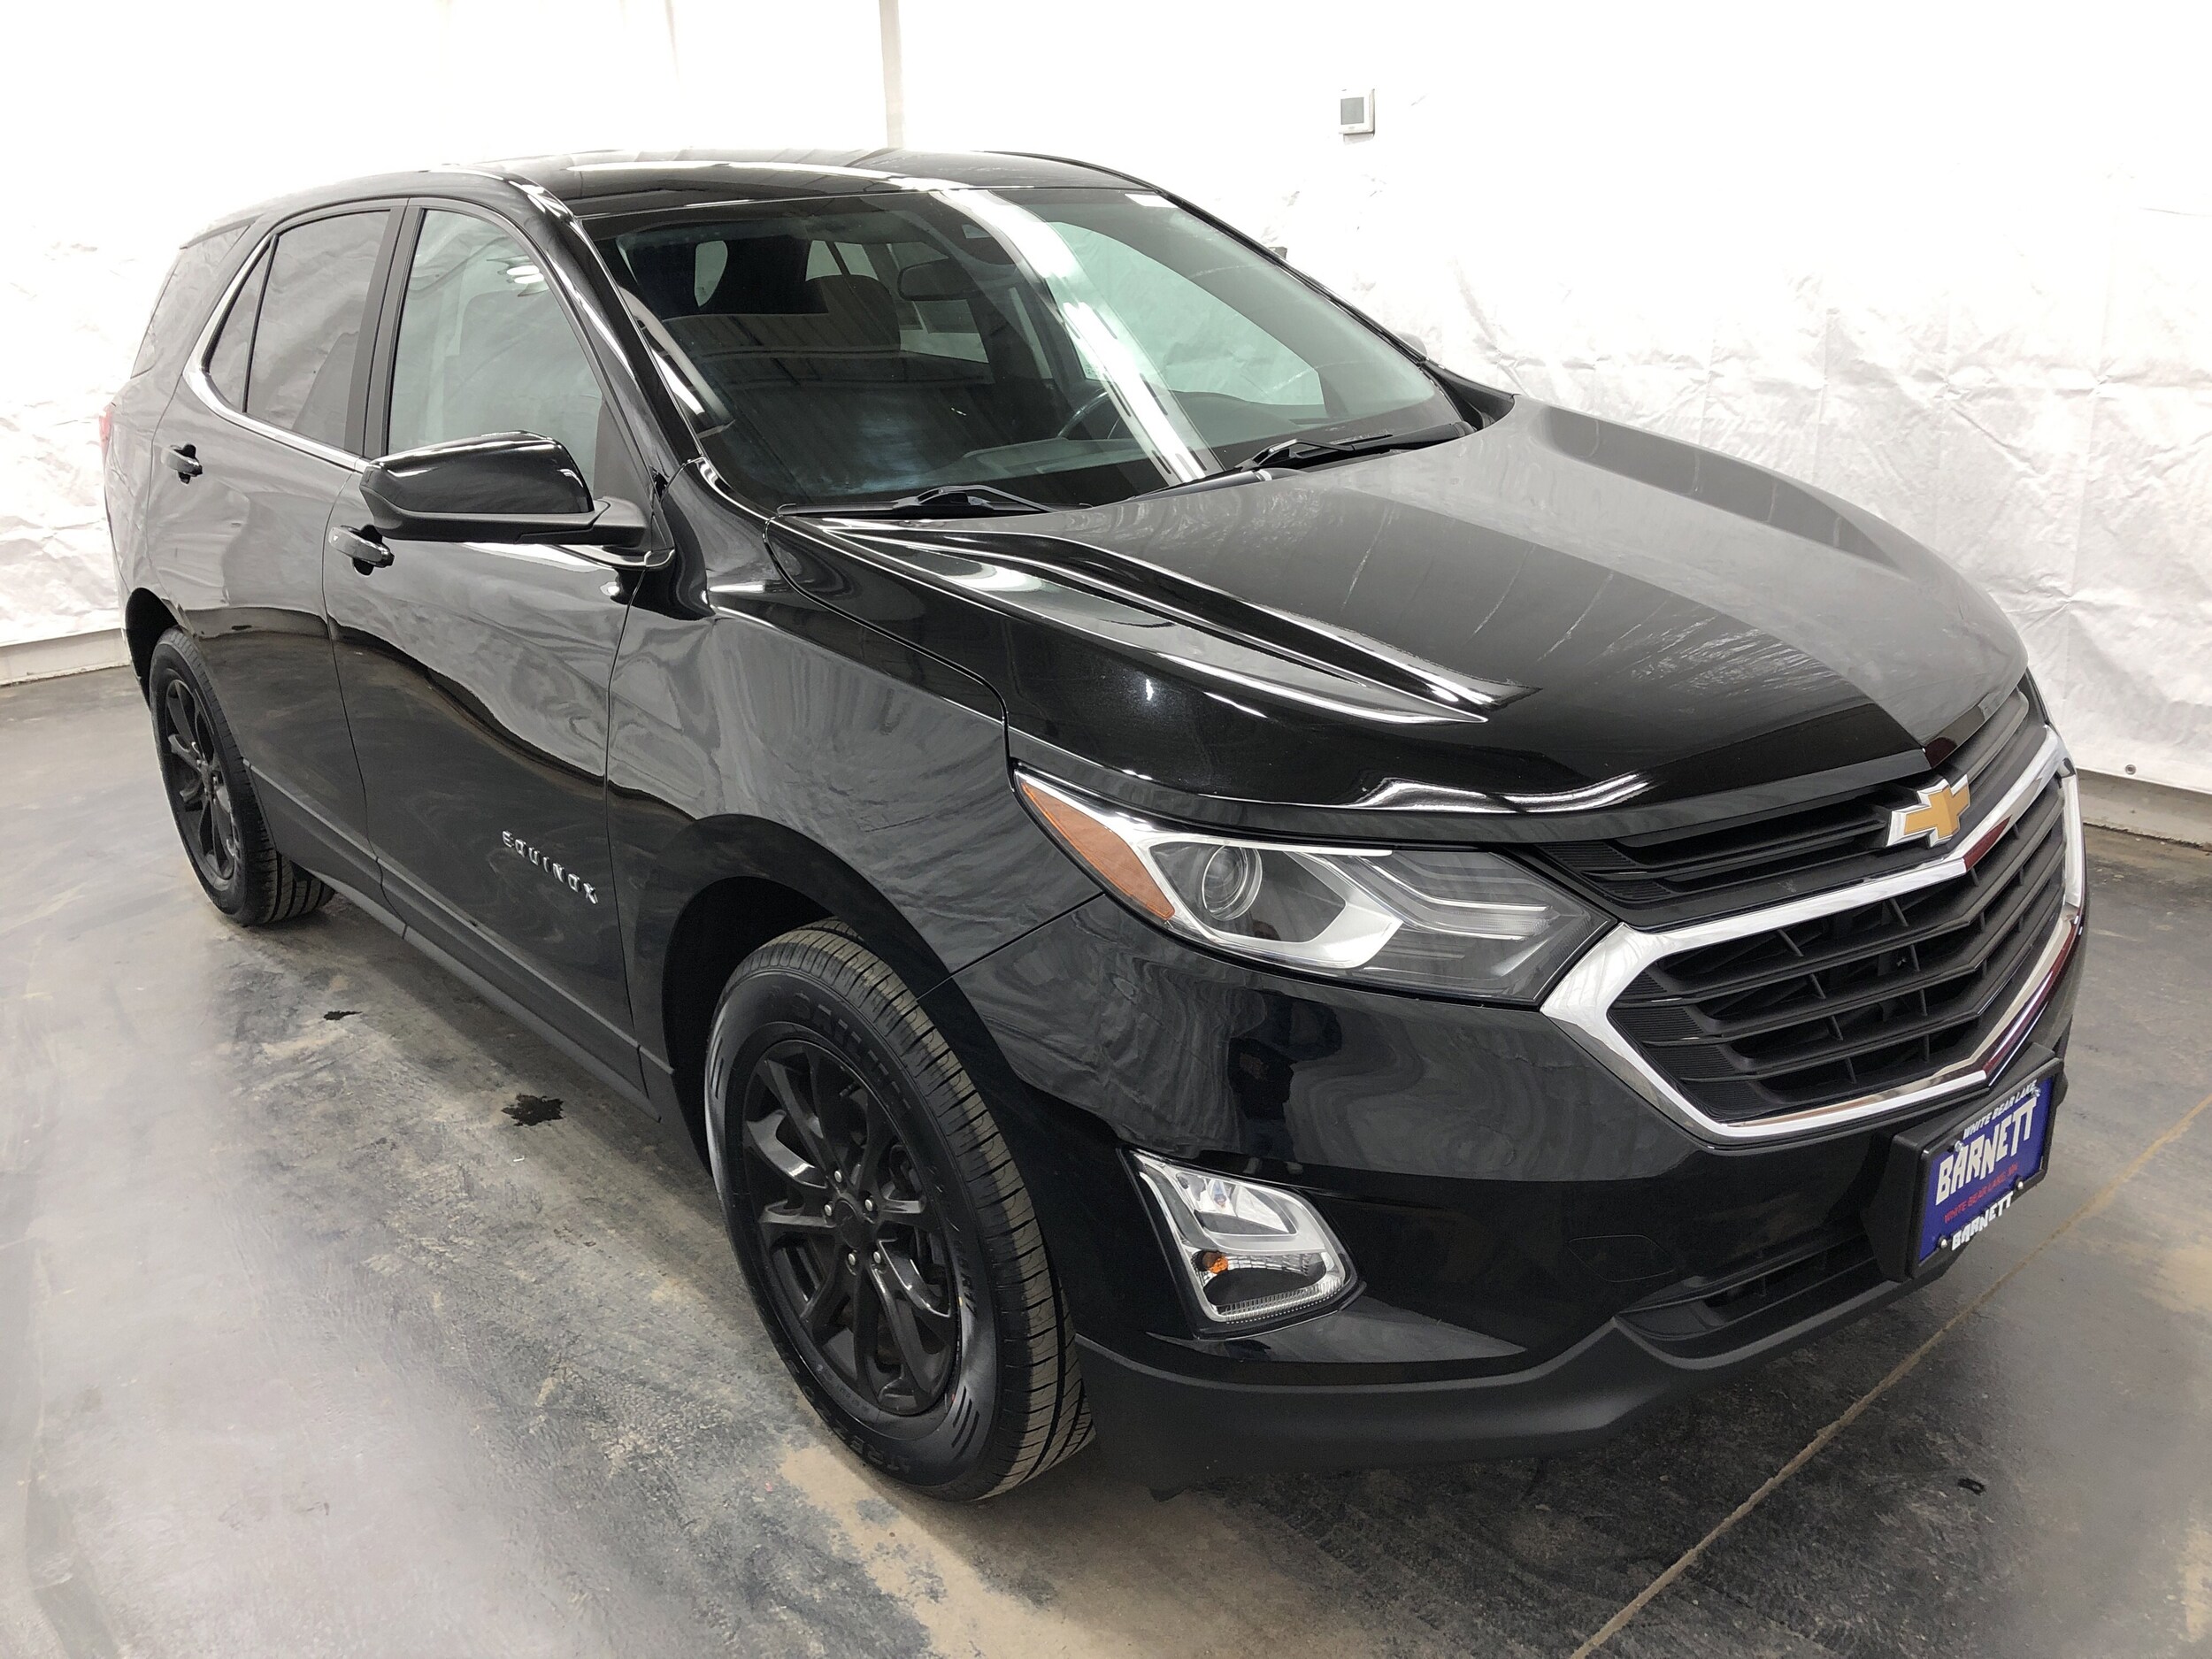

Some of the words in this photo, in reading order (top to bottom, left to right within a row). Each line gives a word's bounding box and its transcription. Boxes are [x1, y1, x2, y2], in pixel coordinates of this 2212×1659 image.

[502, 830, 599, 905] EQUINOX
[1963, 1111, 1992, 1140] WHITE
[1991, 1095, 2015, 1120] BEAR
[2014, 1079, 2038, 1104] LAKE
[1935, 1096, 2038, 1206] BARNETT
[1951, 1191, 2014, 1251] BARNETT
